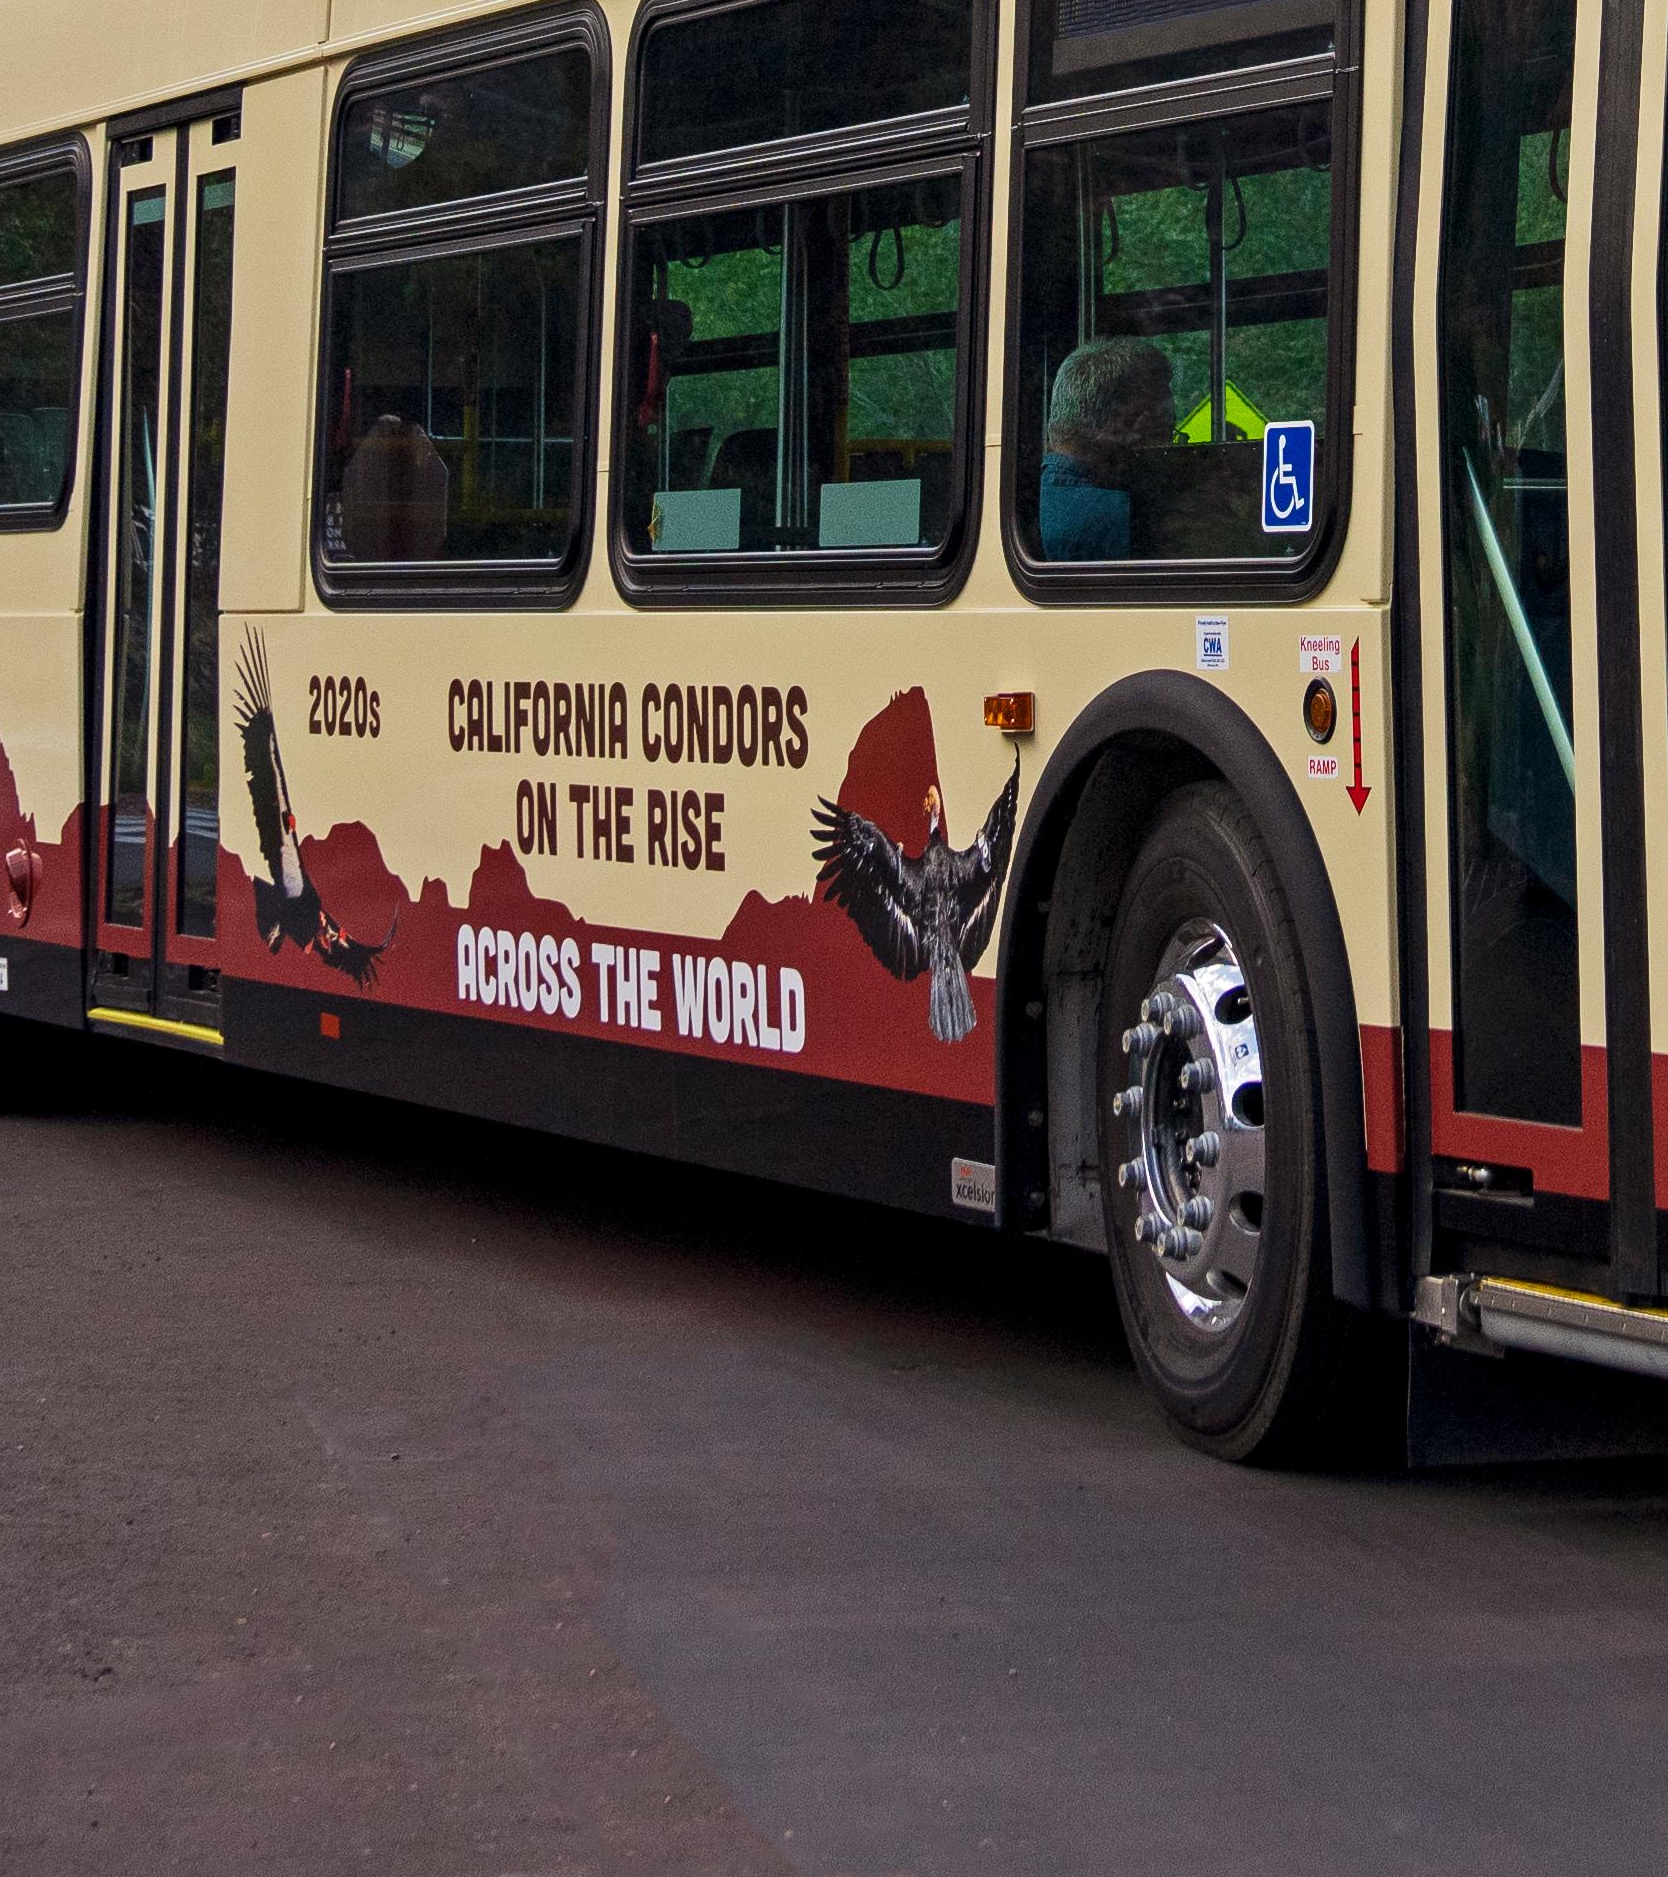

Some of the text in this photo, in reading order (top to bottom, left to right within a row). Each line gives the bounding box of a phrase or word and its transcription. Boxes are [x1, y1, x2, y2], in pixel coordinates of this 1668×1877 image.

[1203, 637, 1222, 654] CWA
[1300, 636, 1340, 655] Kneeling
[1312, 656, 1330, 671] Bus
[309, 675, 381, 739] 2020s
[448, 678, 809, 770] CALIFORNIA CONDORS
[1309, 759, 1337, 775] RAMP
[516, 779, 726, 872] ON THE RISE
[457, 924, 806, 1054] ACROSS THE WORLD
